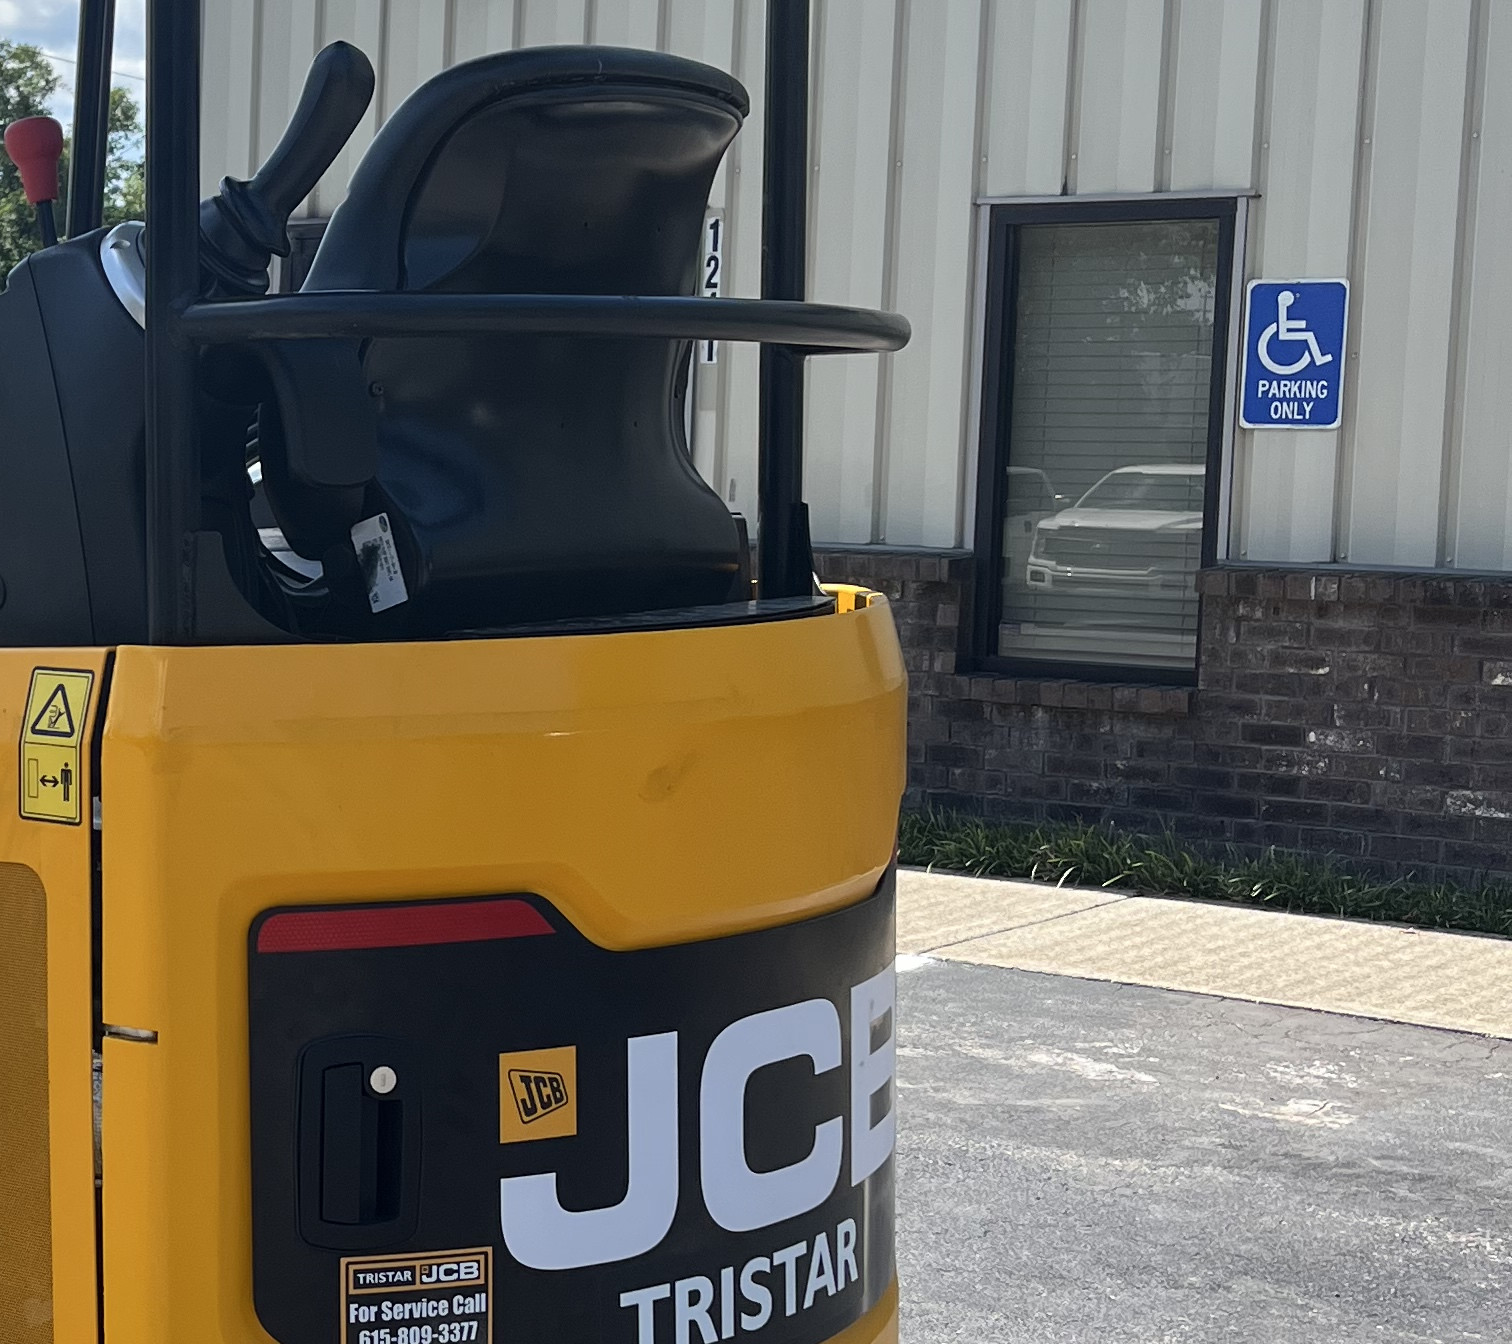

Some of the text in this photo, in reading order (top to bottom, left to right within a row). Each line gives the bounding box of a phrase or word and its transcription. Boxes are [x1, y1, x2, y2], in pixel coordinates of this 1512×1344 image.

[702, 218, 720, 362] 121
[1257, 380, 1328, 399] PARKING
[1270, 401, 1314, 420] ONLY
[518, 1075, 564, 1118] JCB
[356, 1261, 479, 1285] TRISTAR JCB
[349, 1292, 487, 1324] For Service Call
